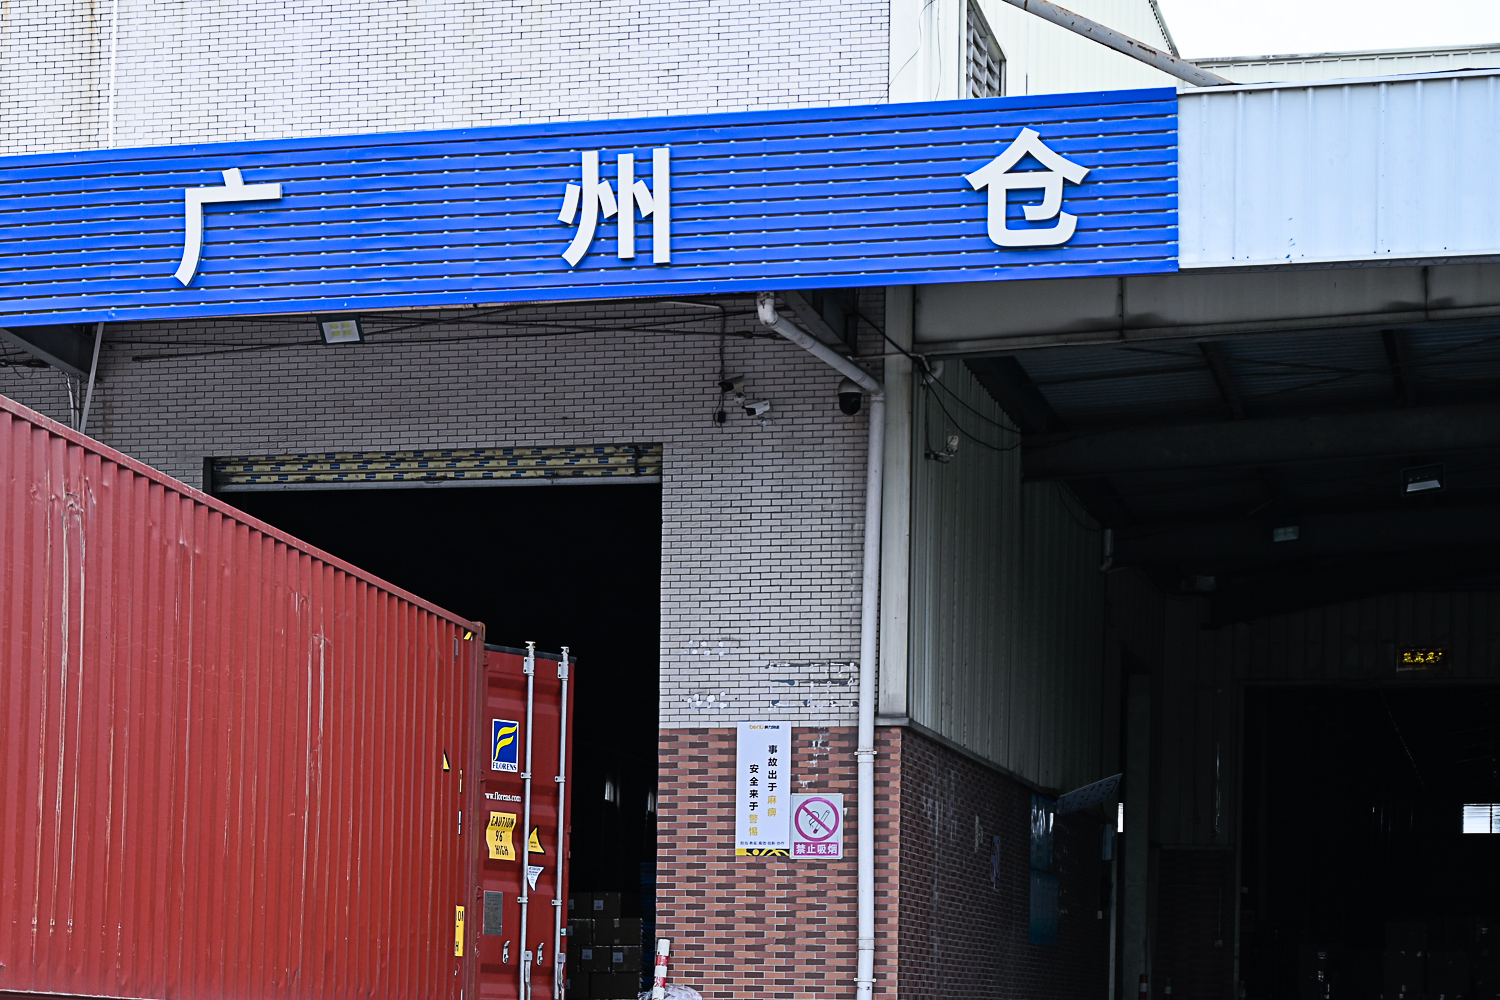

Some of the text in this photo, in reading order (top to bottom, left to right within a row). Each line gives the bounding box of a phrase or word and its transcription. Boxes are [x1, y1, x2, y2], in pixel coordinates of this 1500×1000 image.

[492, 762, 517, 771] FLORENS
[767, 745, 778, 818] 事故出于麻痹
[748, 764, 760, 837] 安全来于警惕
[490, 815, 515, 829] CAUTION
[795, 843, 838, 854] 禁止吸烟
